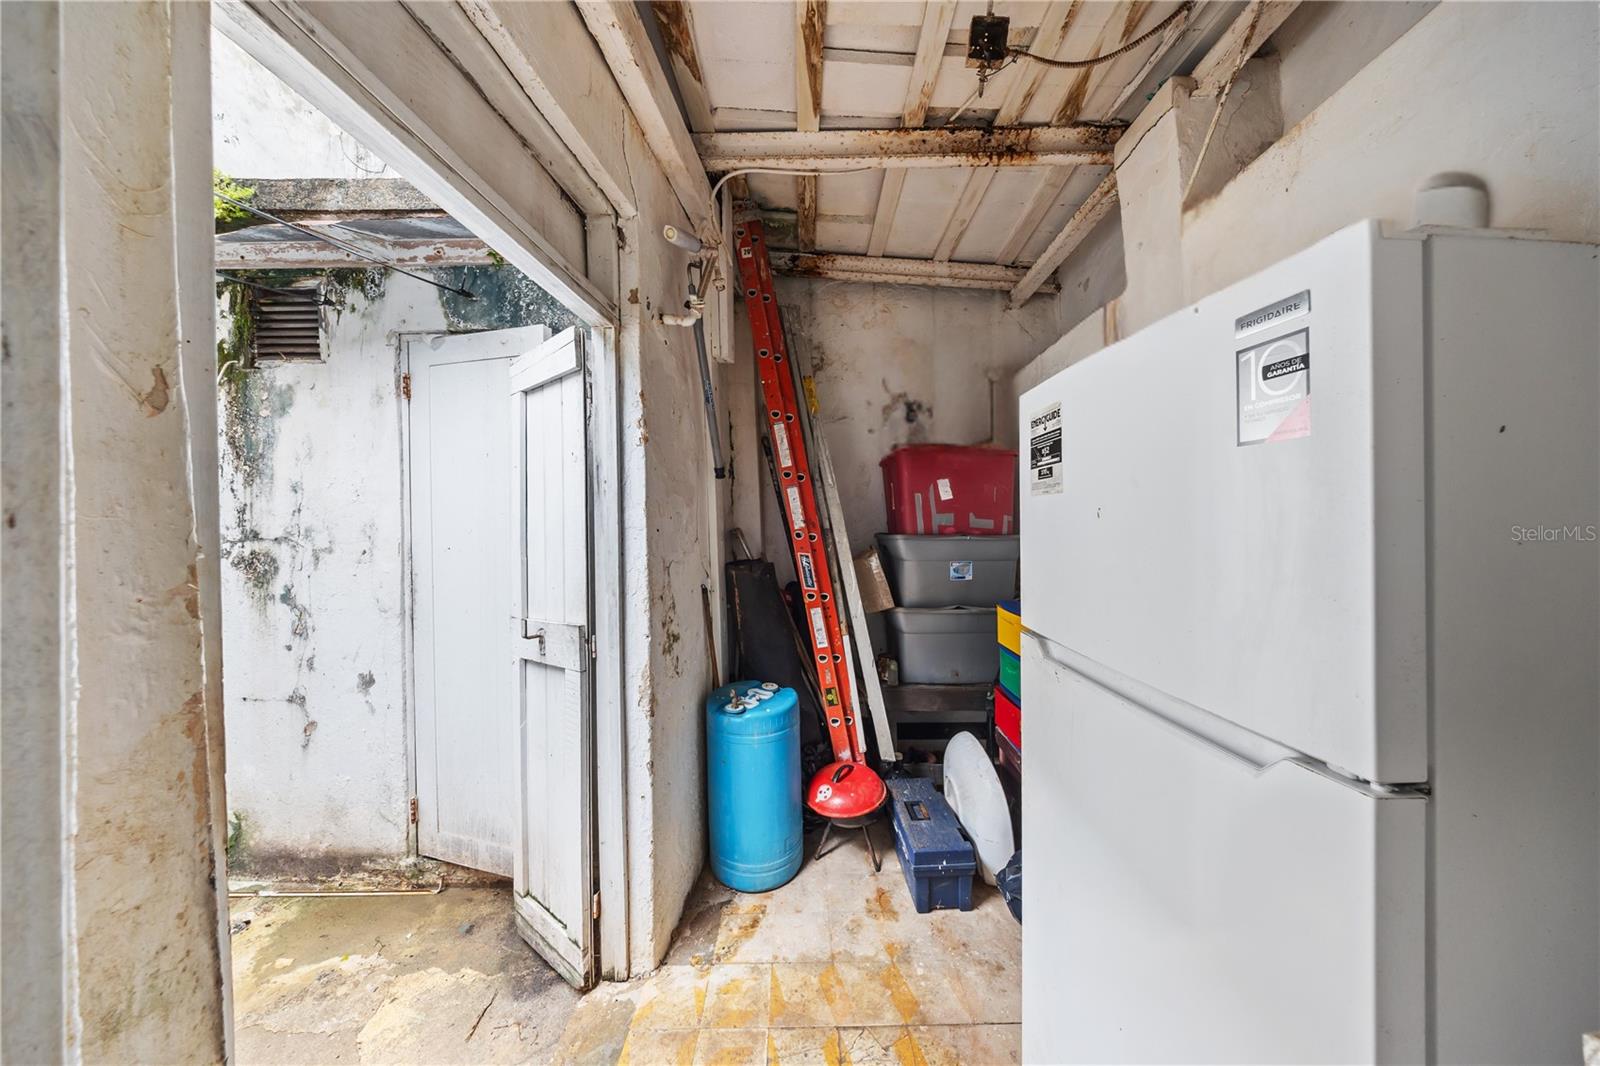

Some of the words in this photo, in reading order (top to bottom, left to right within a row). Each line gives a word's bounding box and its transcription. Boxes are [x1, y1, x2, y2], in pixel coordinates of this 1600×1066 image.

[1239, 303, 1301, 331] FRIGIDAIRE
[1267, 362, 1305, 378] GARANTÍA
[1270, 360, 1290, 372] AÑOS
[1291, 356, 1303, 365] DE
